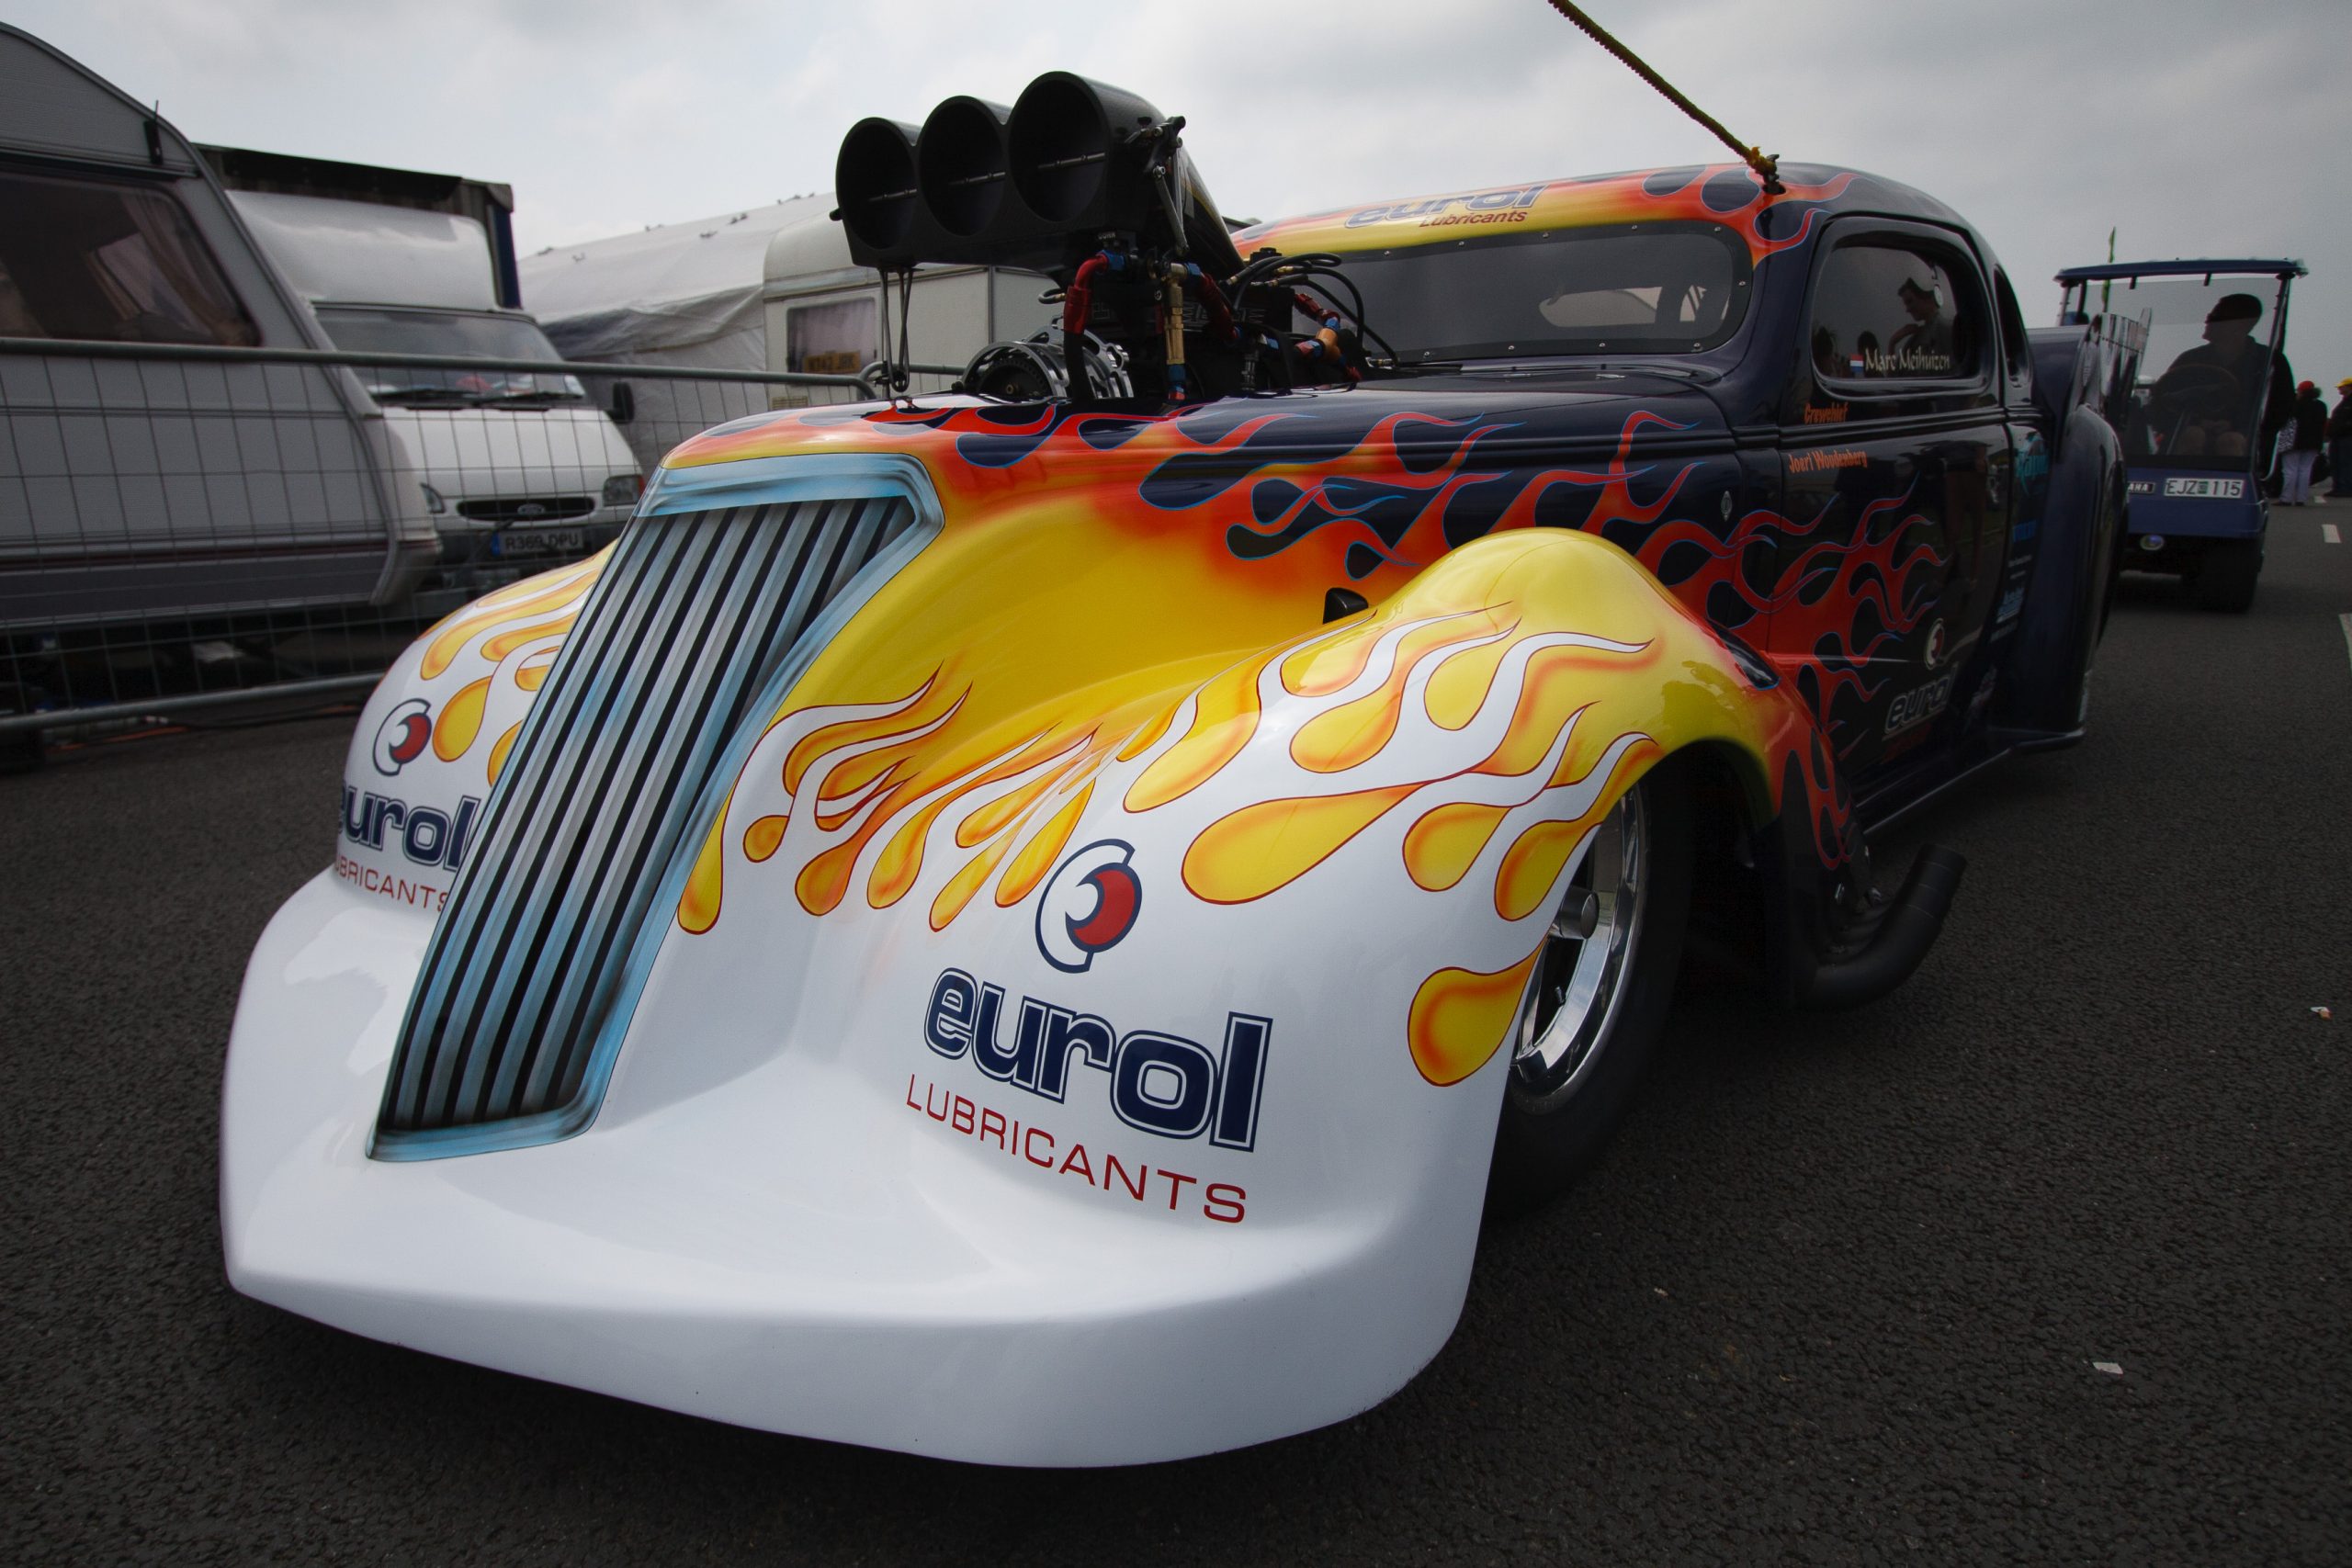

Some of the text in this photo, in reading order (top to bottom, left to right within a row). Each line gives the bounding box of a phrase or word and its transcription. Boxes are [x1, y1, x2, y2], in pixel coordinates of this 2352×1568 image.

[1344, 183, 1550, 229] eurol
[1419, 209, 1528, 228] Lubricants
[1865, 347, 1896, 371] Marc
[2166, 479, 2241, 496] EJZ 115
[548, 533, 579, 549] DPU
[340, 784, 481, 872] urol
[923, 967, 1273, 1153] eurol
[906, 1074, 1247, 1224] LUBRICANTS
